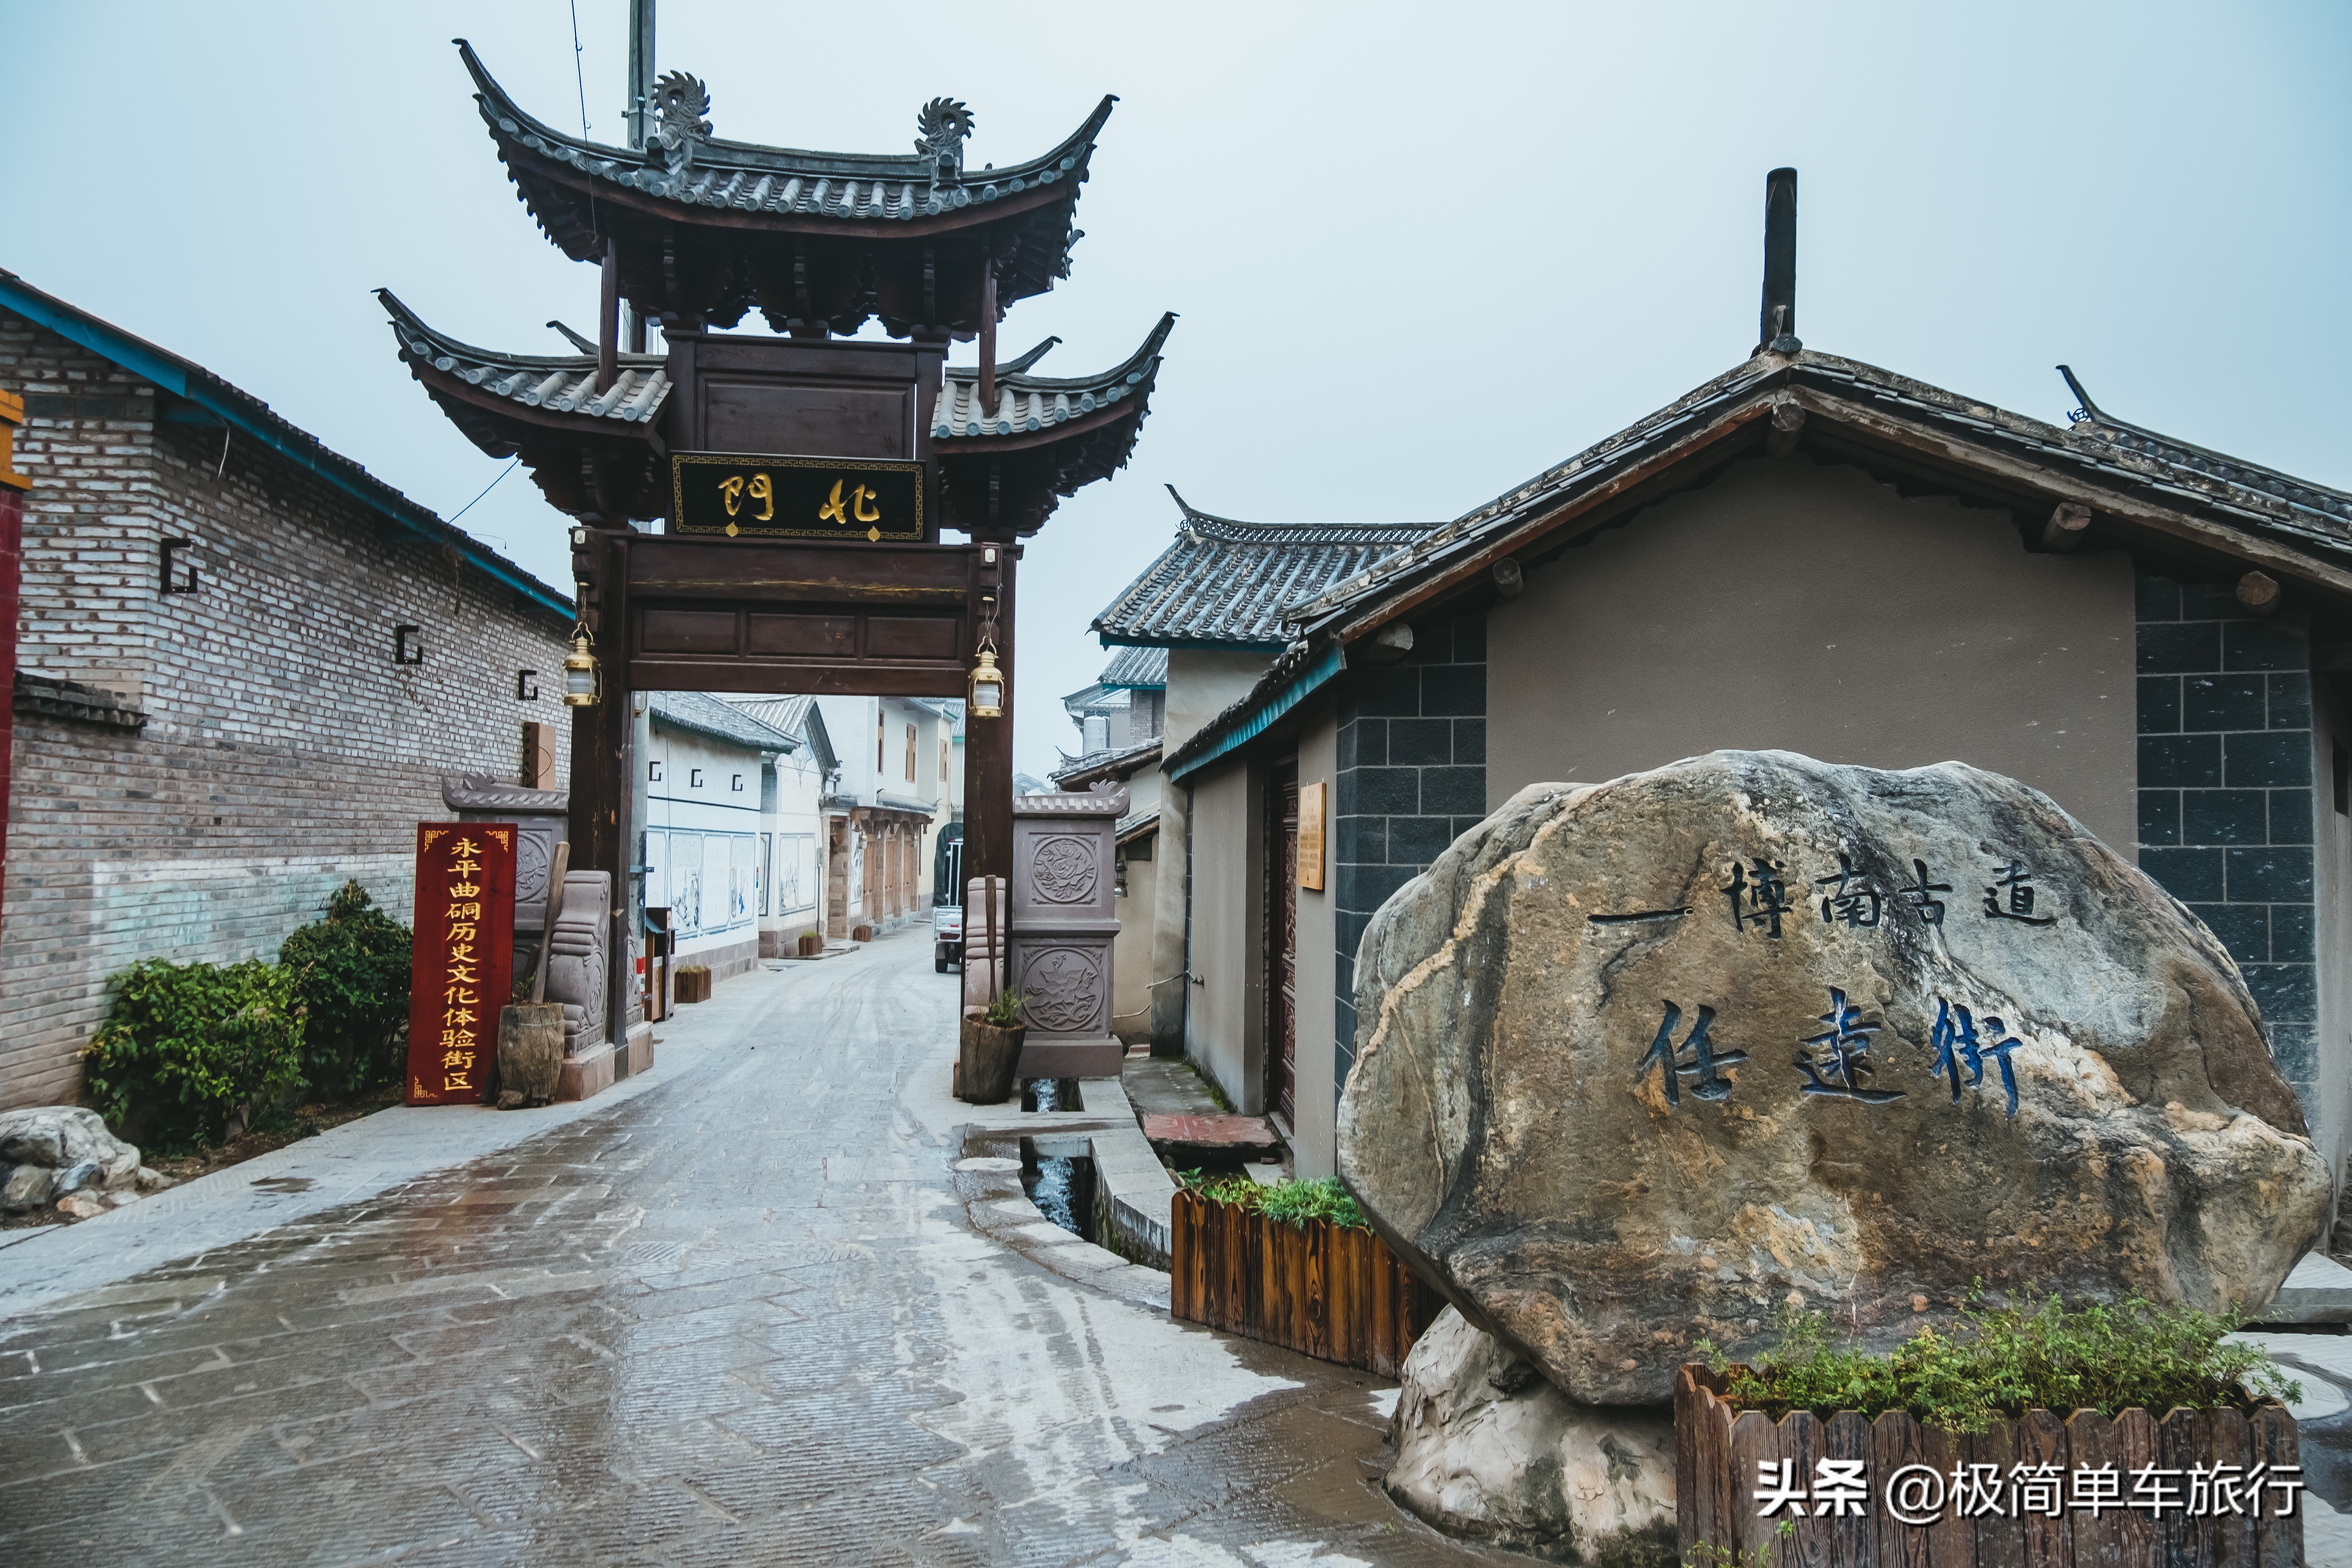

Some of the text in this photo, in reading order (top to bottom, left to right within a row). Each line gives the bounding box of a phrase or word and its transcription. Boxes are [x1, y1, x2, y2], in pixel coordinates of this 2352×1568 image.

[439, 837, 484, 1090] 永平曲硐历史文化体验街区
